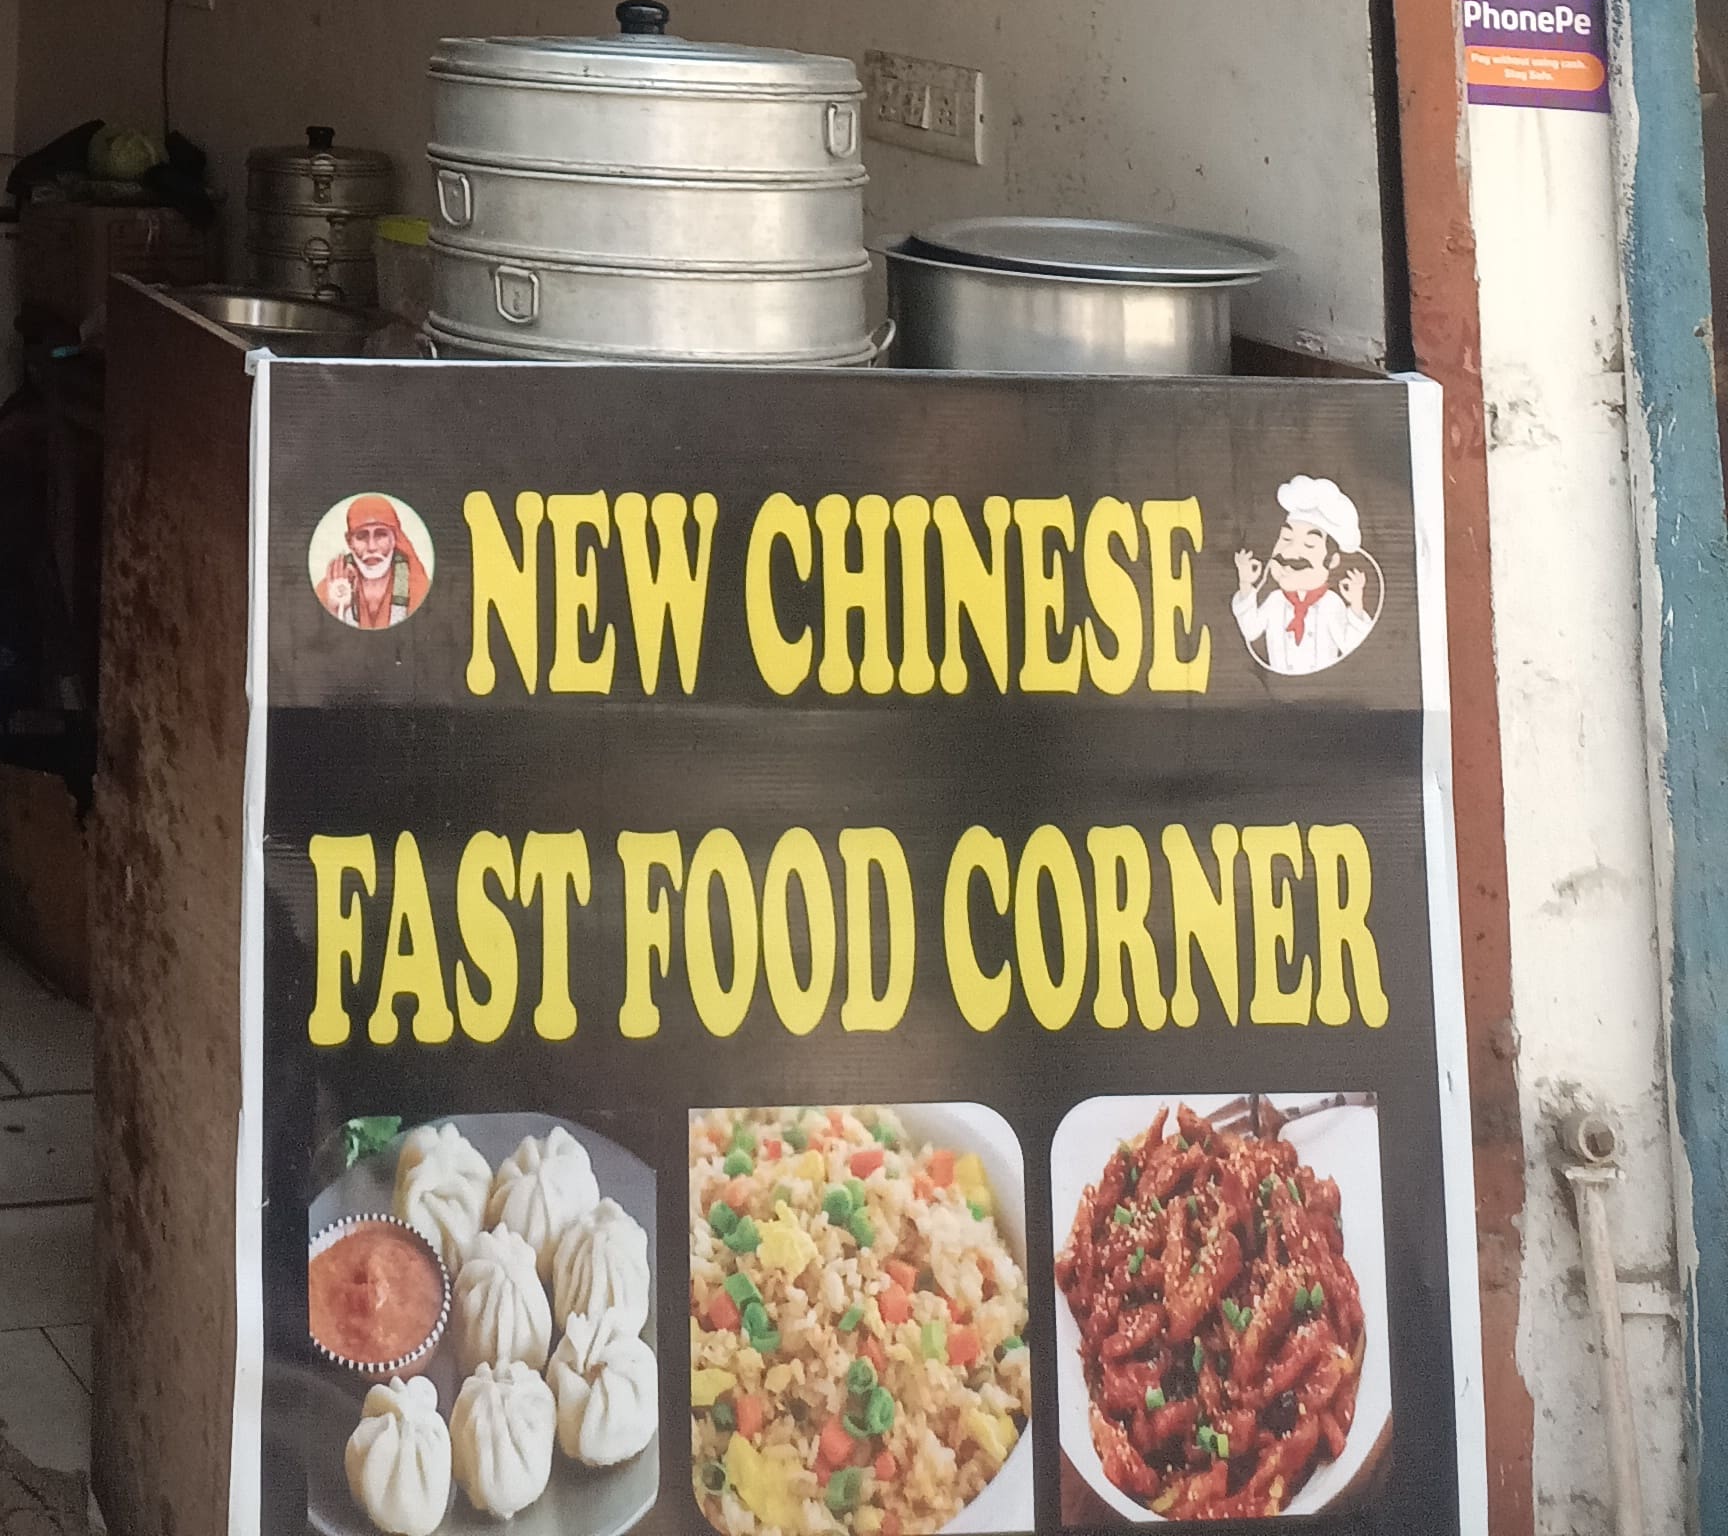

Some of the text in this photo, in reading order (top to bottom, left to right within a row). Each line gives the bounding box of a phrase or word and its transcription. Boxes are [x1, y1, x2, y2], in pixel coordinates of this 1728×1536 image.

[1463, 0, 1592, 35] PhonePe
[463, 490, 1213, 698] NEW CHINESE
[308, 823, 1390, 1046] FAST FOOD CORNER
